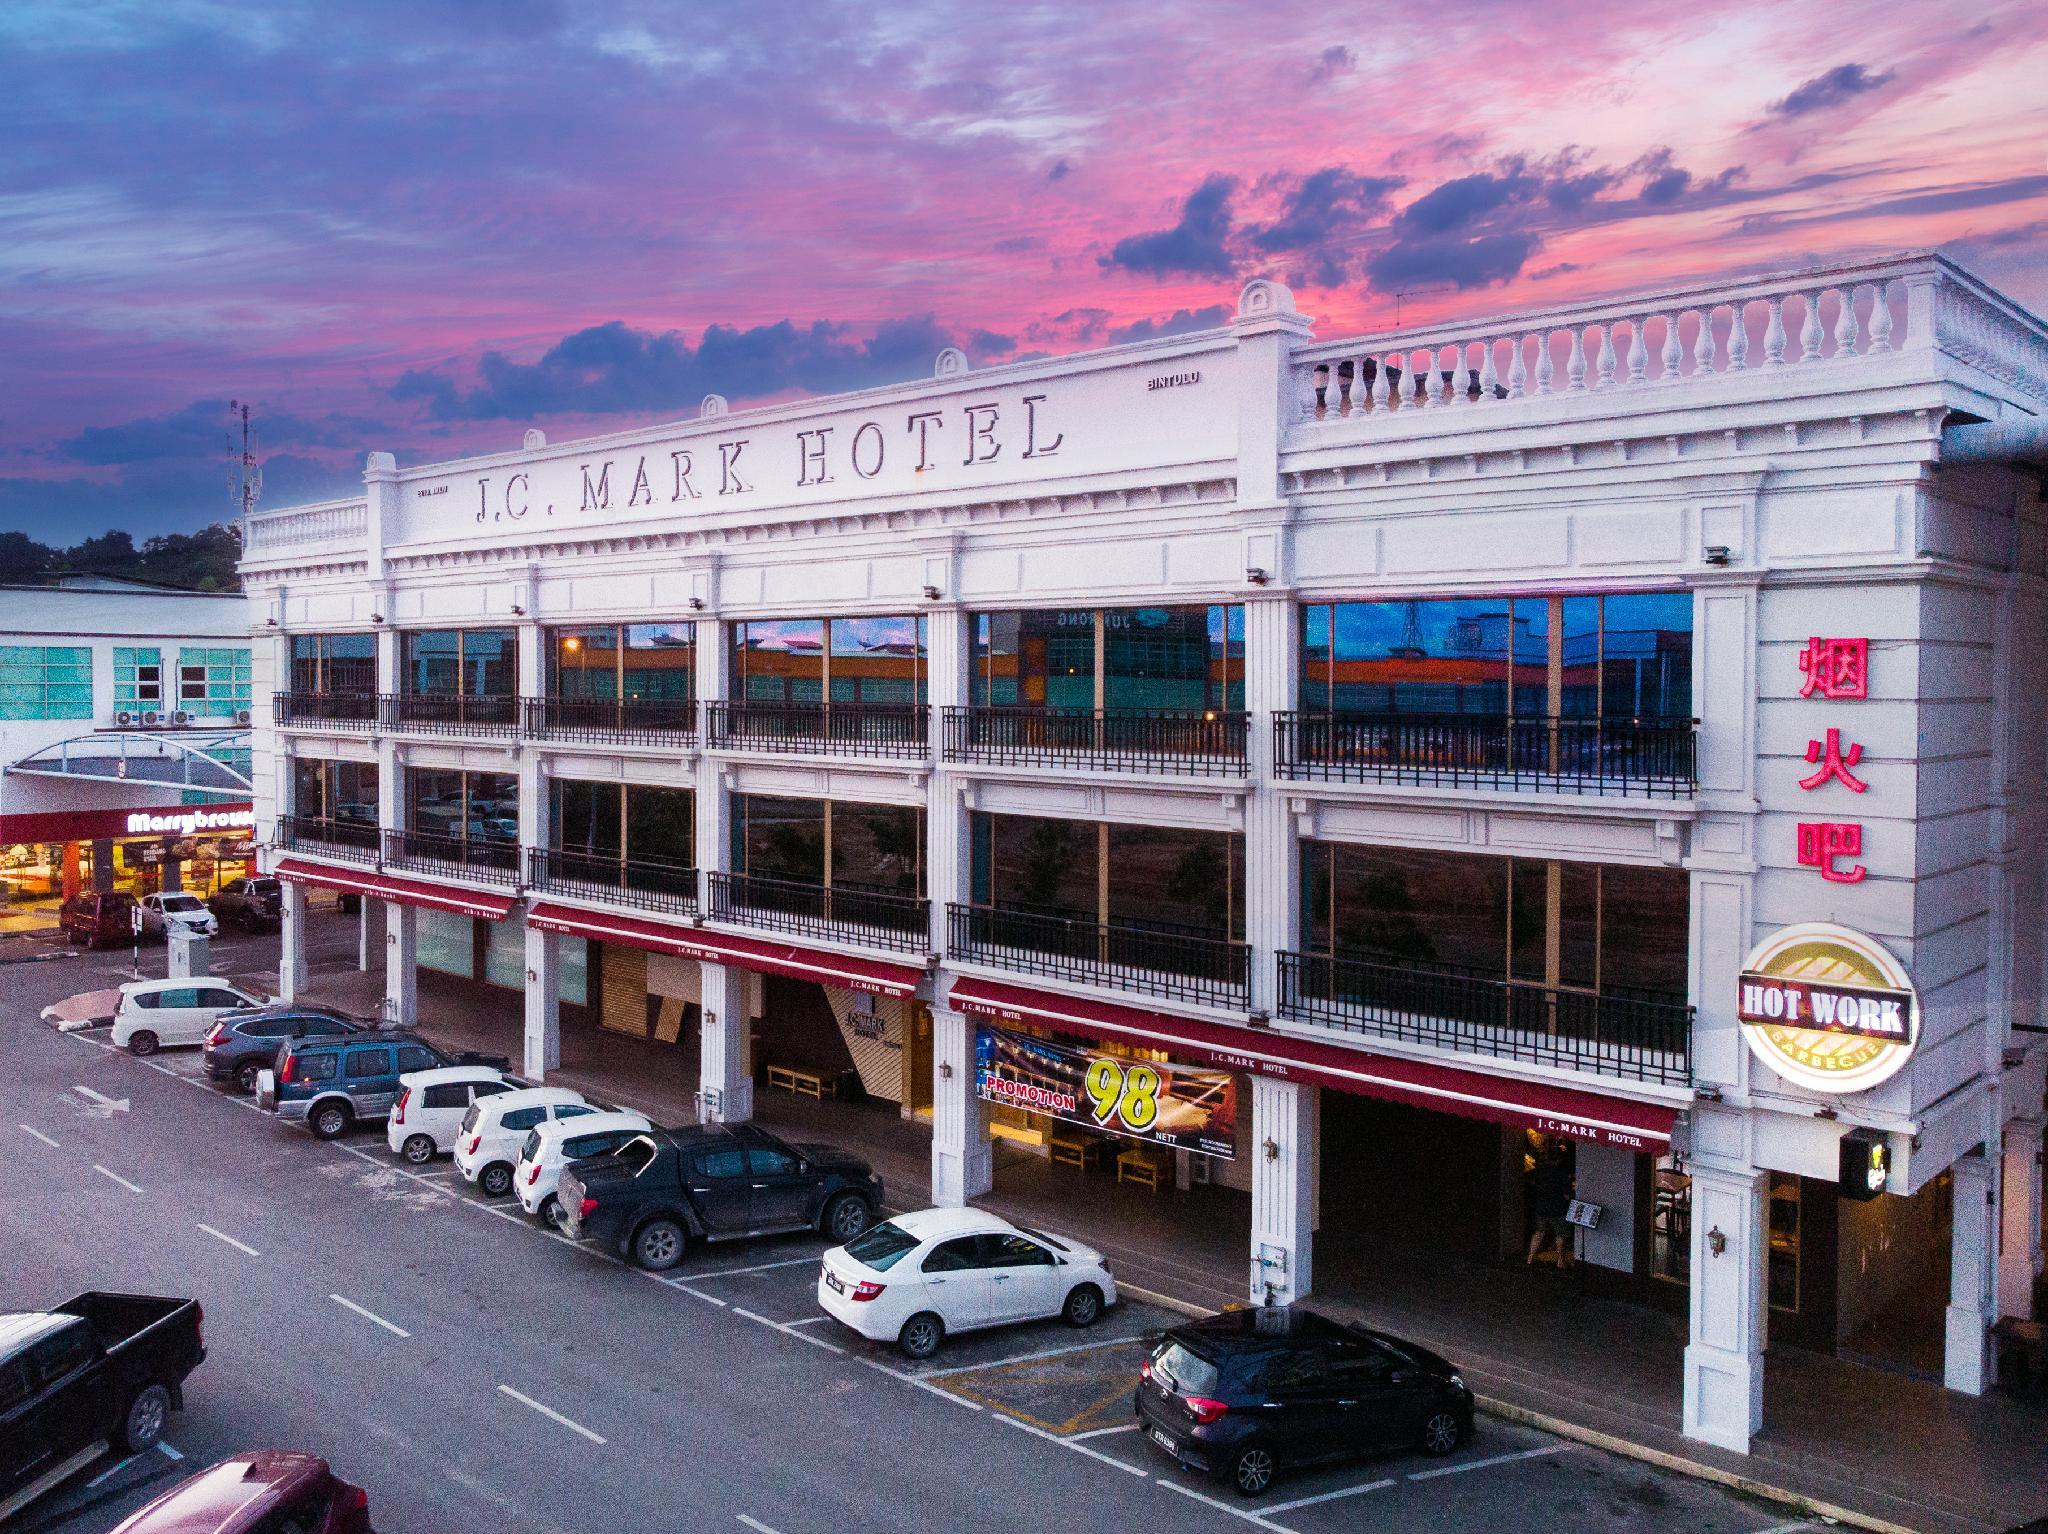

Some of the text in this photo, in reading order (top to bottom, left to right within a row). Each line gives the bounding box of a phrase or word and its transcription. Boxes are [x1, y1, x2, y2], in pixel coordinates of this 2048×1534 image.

[1148, 371, 1200, 391] BINTULU
[797, 394, 1064, 487] HOTEL
[1798, 636, 1868, 883] 烟火吧
[884, 987, 902, 996] HOTEL
[1002, 1010, 1022, 1020] HOTEL
[1743, 985, 1902, 1033] HOT WORK
[1263, 1062, 1288, 1075] HOTEL
[986, 1075, 1076, 1112] PROMOTION
[1085, 1058, 1161, 1133] 98
[1155, 1131, 1177, 1143] NETT
[1608, 1132, 1642, 1147] HOTEL
